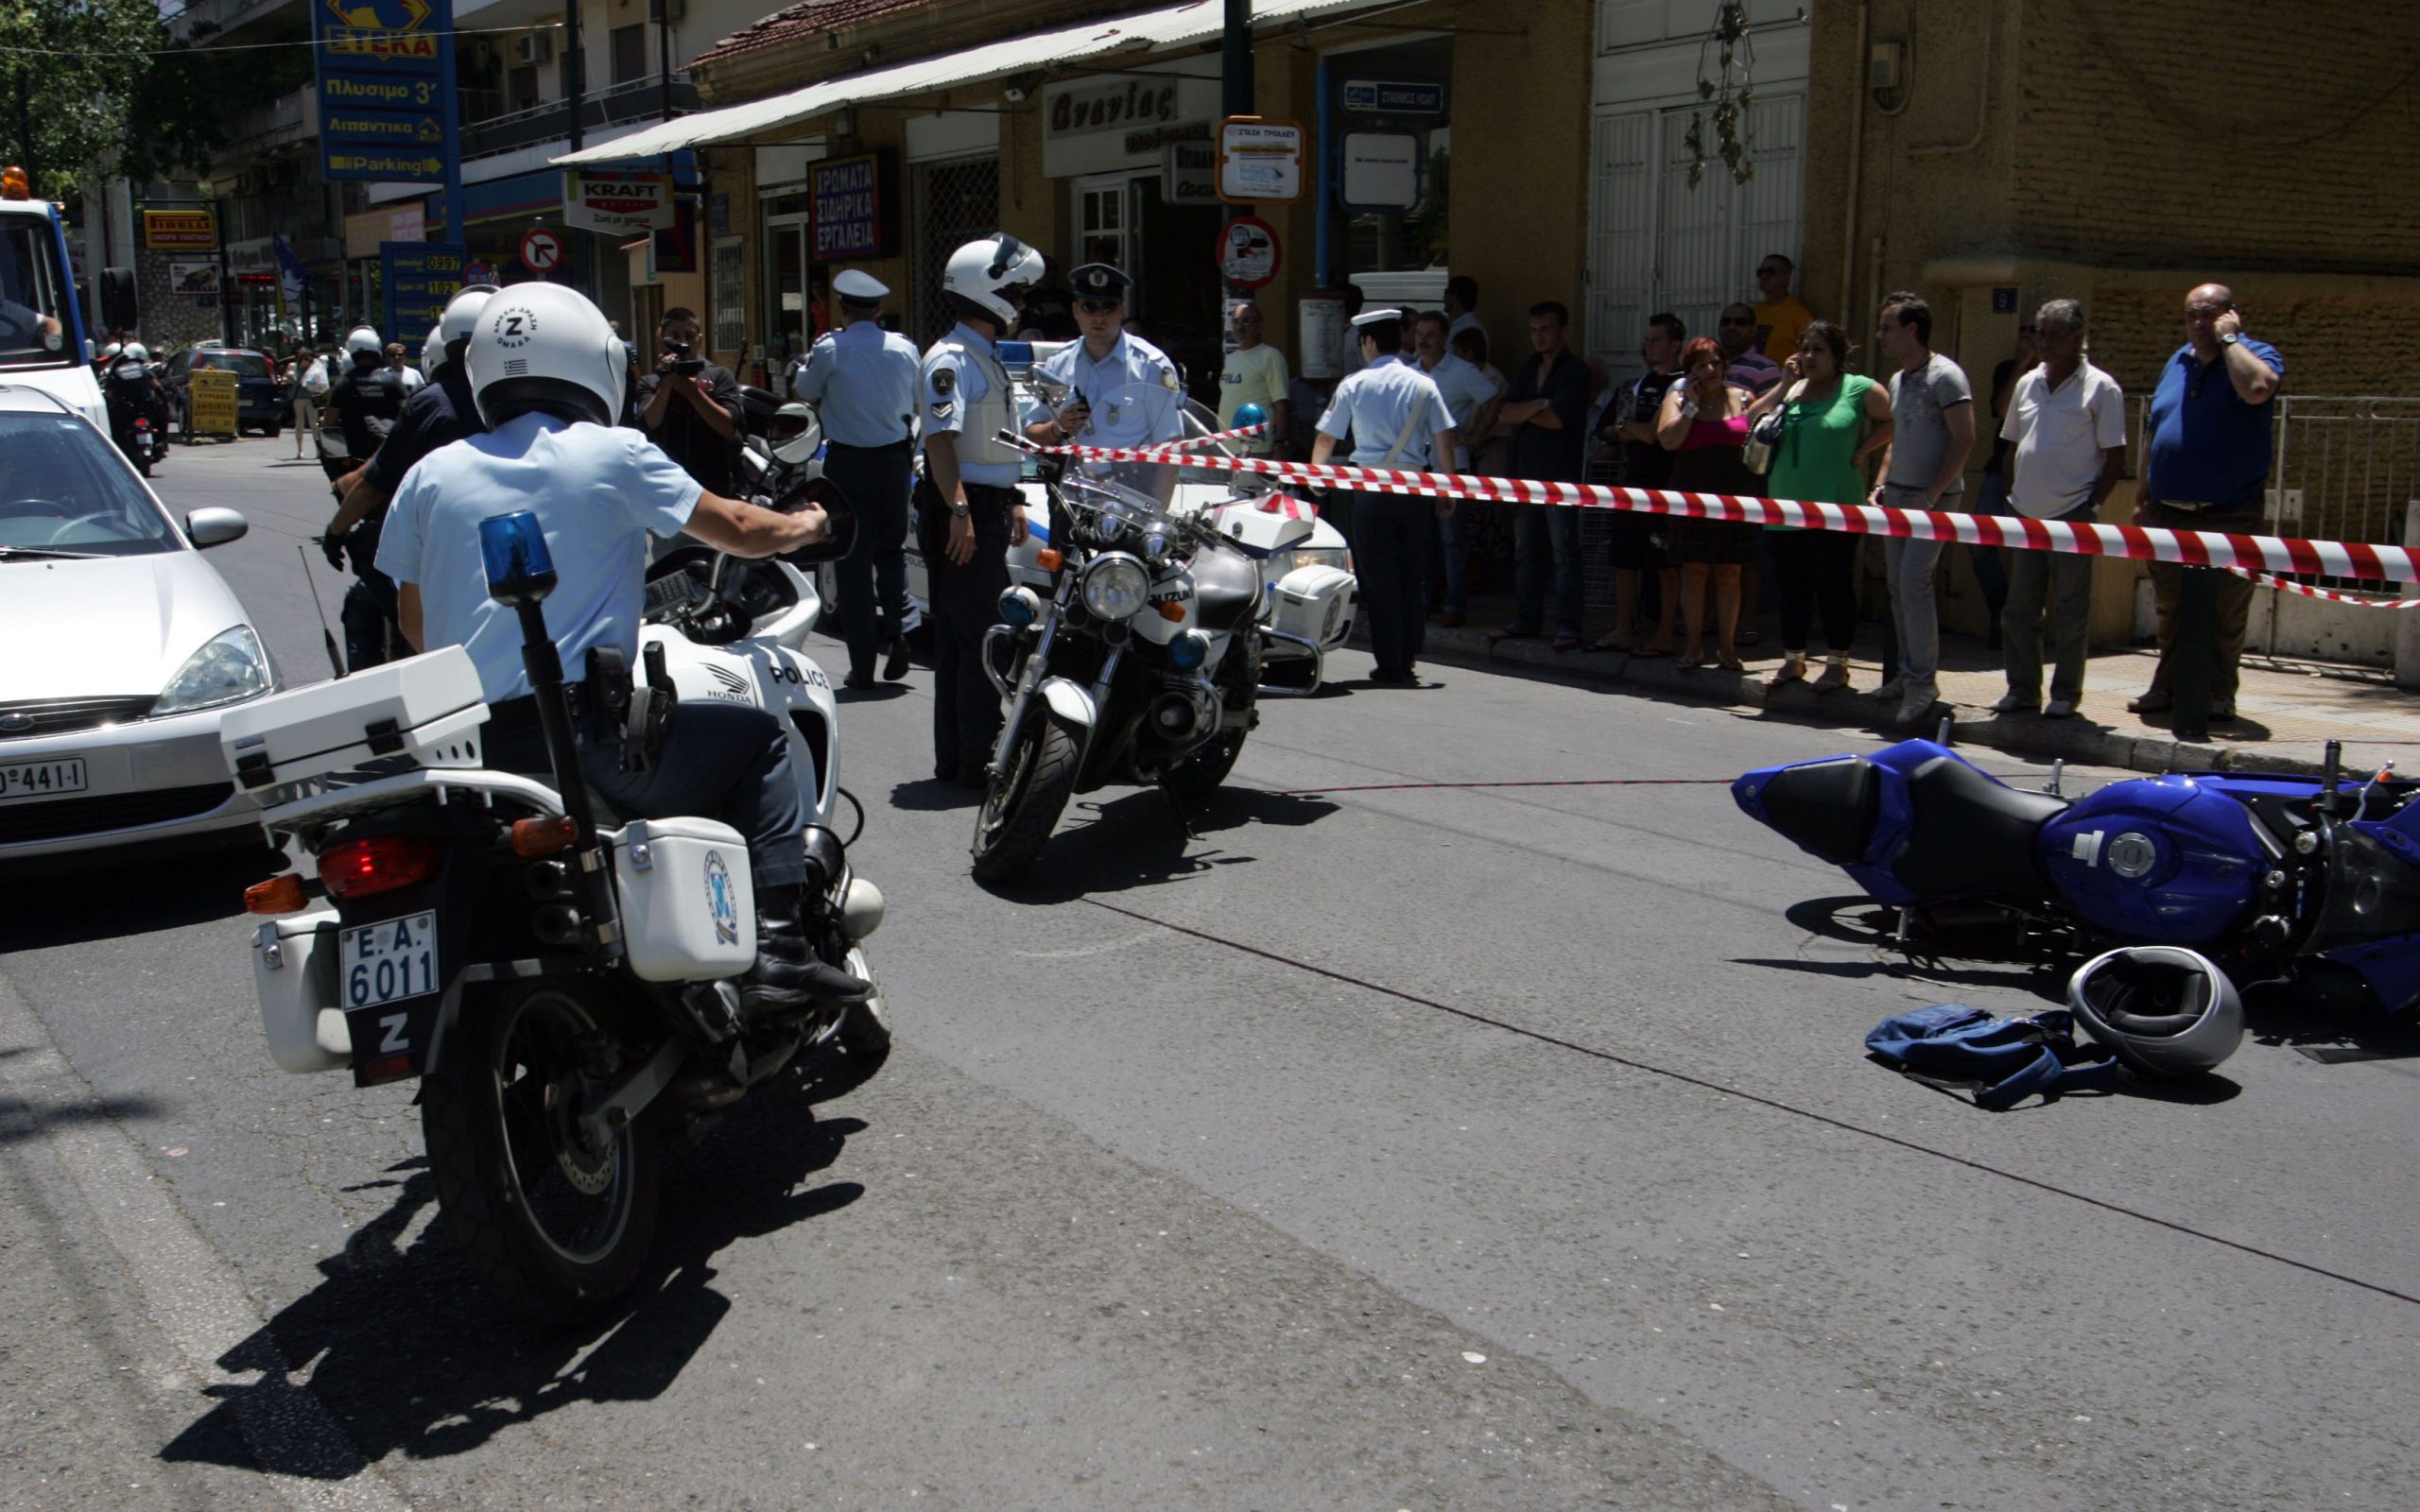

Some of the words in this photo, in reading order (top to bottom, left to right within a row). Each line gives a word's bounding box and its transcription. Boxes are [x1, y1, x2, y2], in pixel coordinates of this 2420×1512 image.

[353, 156, 424, 177] Parking
[816, 163, 873, 196] ΧΡΩΜΑΤΑ
[584, 183, 658, 197] KRAFT
[816, 192, 873, 224] ΣΙΔΗΡΙΚΑ
[150, 215, 210, 229] PIRELLI
[817, 220, 875, 251] ΕΡΓΑΛΕΙΑ
[428, 257, 460, 269] 0997
[1998, 293, 2007, 309] 9
[505, 317, 523, 337] Z
[496, 335, 532, 349] ΟΜΑΔΑ
[769, 666, 829, 690] POLICE
[707, 690, 752, 704] HONDA
[350, 951, 432, 1005] 6011
[379, 1012, 410, 1054] Z
